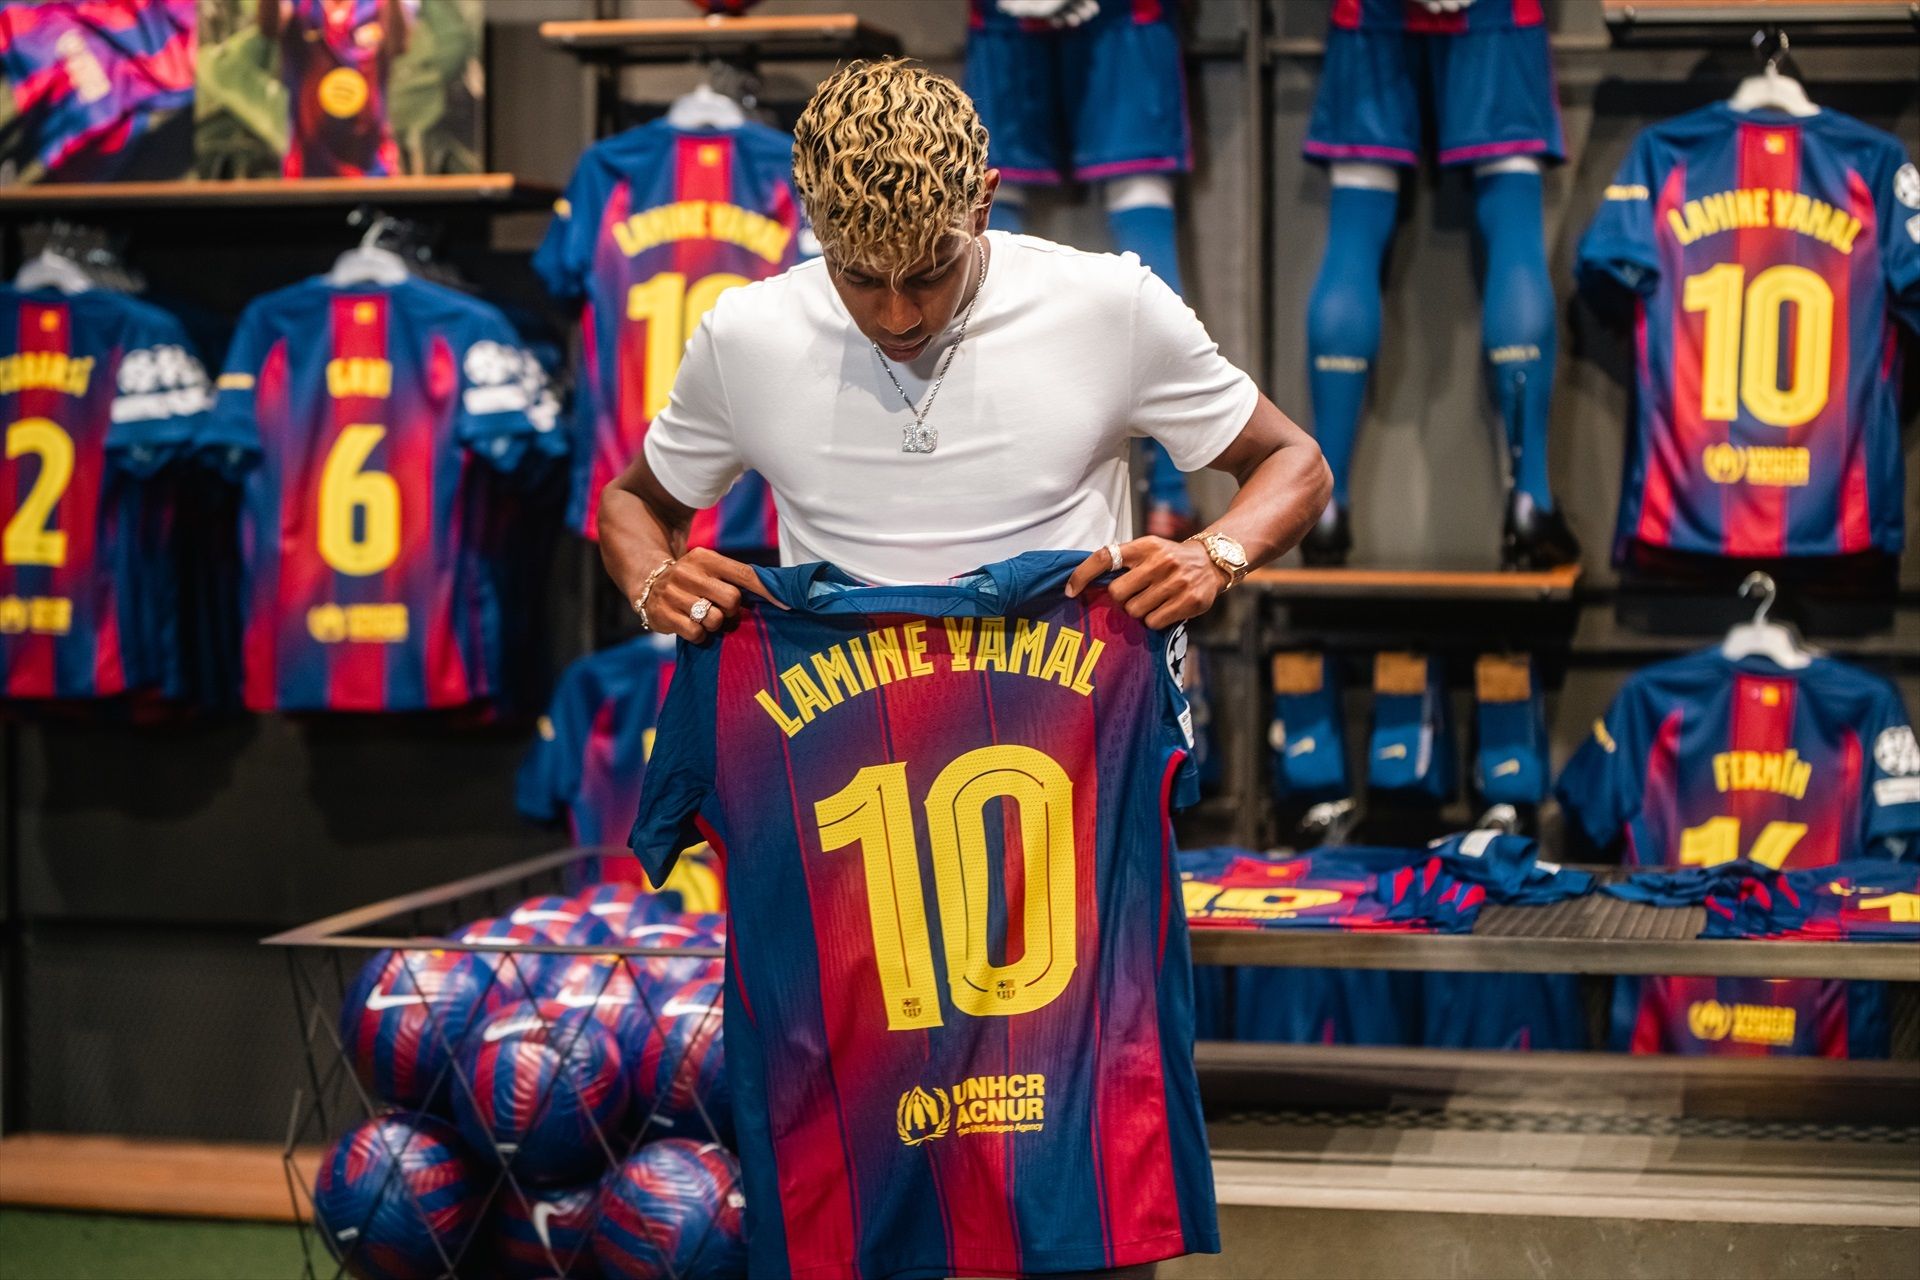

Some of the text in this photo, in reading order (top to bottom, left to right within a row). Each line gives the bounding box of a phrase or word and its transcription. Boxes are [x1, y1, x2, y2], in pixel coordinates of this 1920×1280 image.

[627, 272, 753, 422] 1
[1684, 263, 1833, 427] 10
[3, 417, 75, 566] 2
[317, 424, 400, 576] 6
[754, 617, 1106, 738] LAMINE YAMAL
[814, 744, 1077, 1031] 10
[952, 1074, 1045, 1105] UNHCR
[956, 1097, 1044, 1129] ACNUR
[1014, 1122, 1044, 1133] Agency
